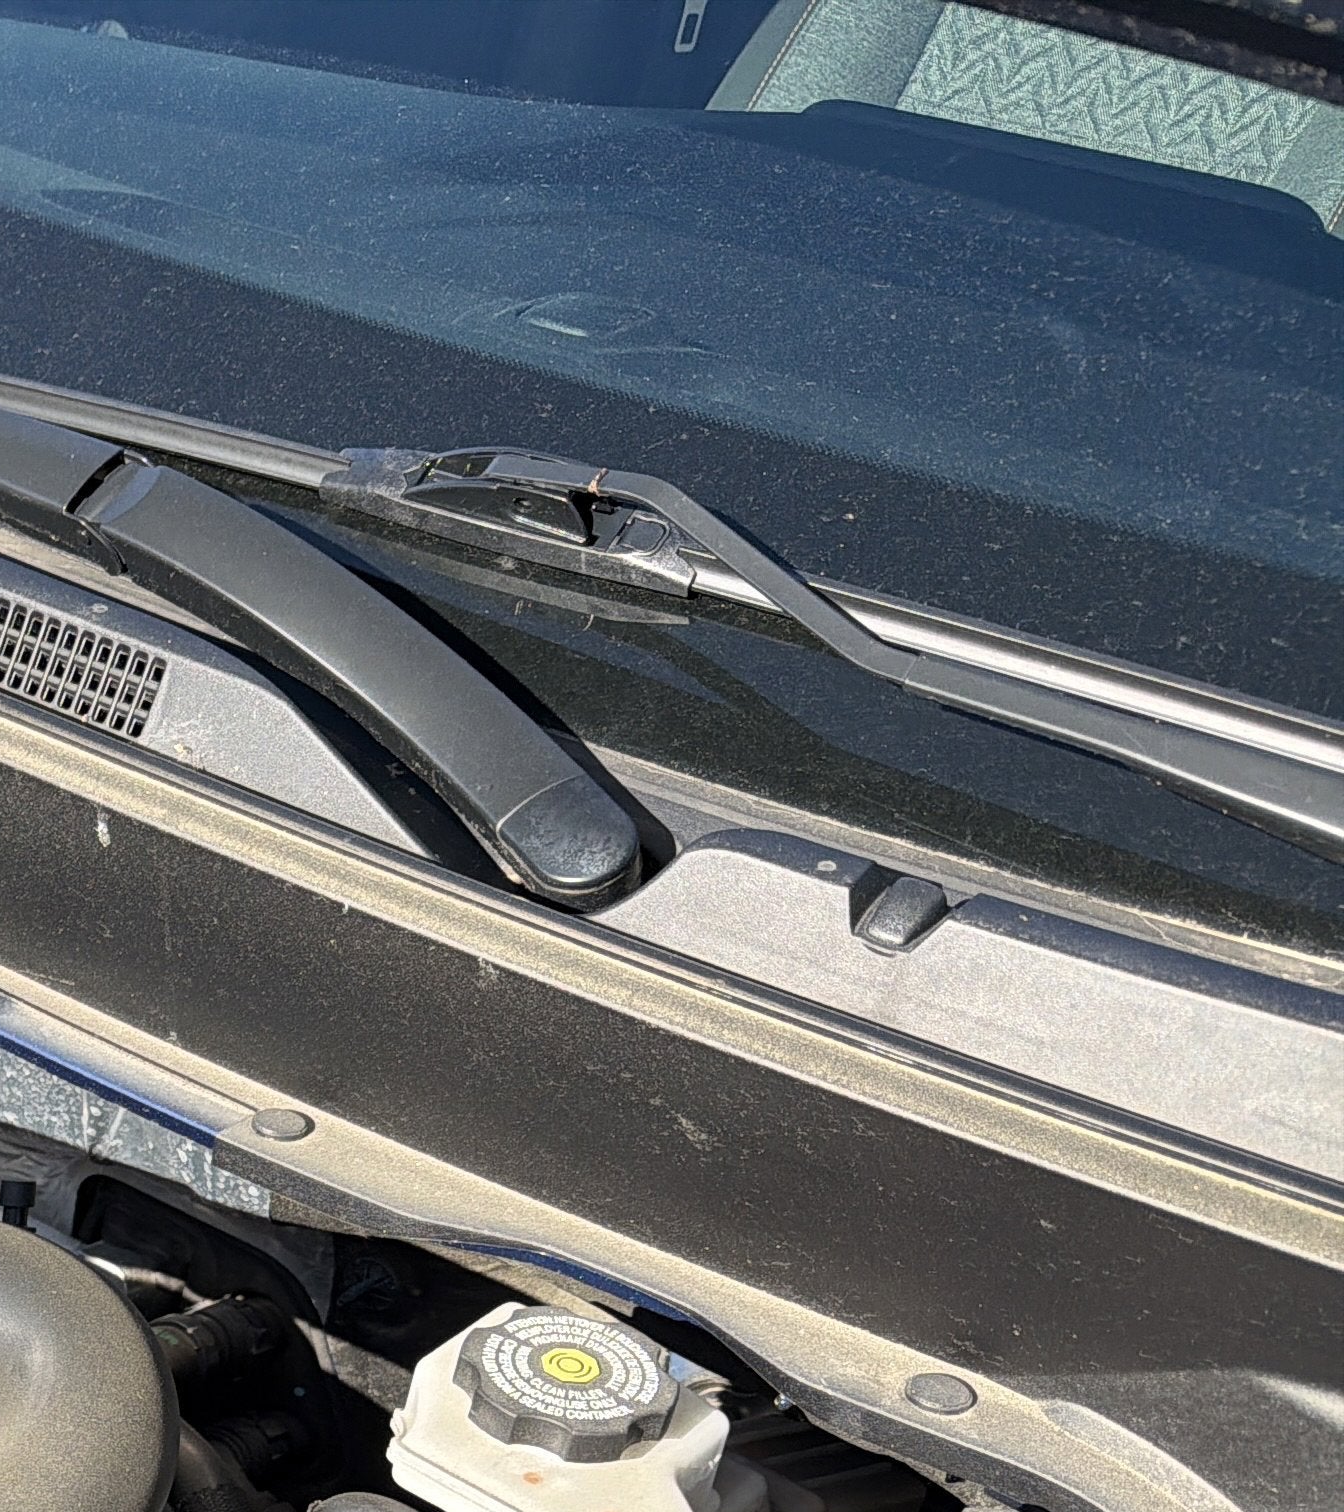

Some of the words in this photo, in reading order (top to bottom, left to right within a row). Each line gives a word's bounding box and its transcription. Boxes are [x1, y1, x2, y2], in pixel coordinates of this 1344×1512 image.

[530, 1377, 567, 1398] CLEAN
[567, 1388, 607, 1403] FILLER
[519, 1398, 564, 1417] SEALED
[565, 1405, 635, 1421] CONTAINER
[566, 1399, 589, 1411] USE
[589, 1396, 618, 1410] ONLY
